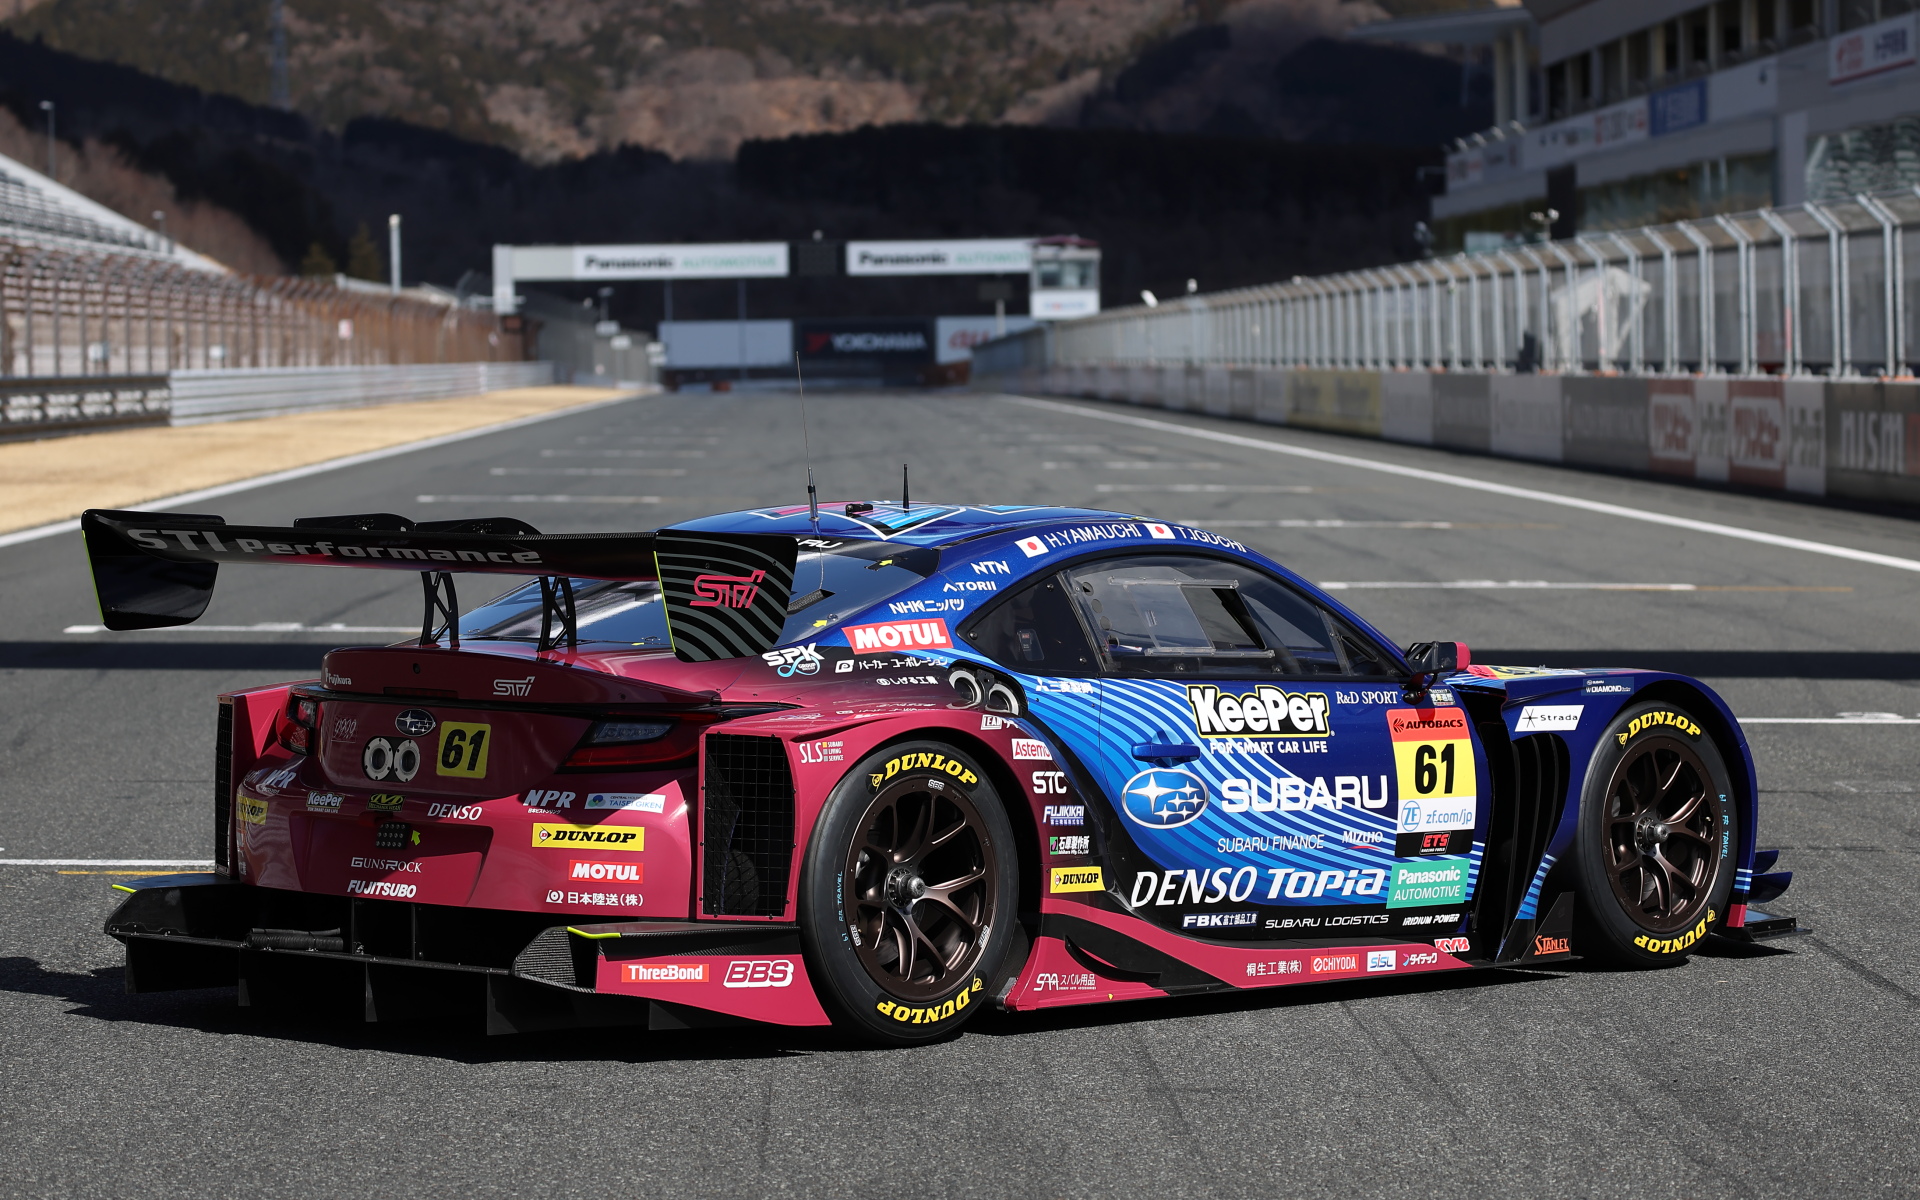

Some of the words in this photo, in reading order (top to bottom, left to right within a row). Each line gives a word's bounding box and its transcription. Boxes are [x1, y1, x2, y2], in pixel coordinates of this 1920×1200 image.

[584, 253, 674, 272] Panasonic
[681, 253, 777, 270] AUTOMOTIVE
[831, 332, 927, 352] YOKOHAMA
[126, 528, 225, 553] STI
[1044, 523, 1142, 548] H.YAMAUCHI
[1174, 526, 1247, 553] T.IGUCHI
[970, 560, 1011, 574] NTN
[853, 622, 947, 649] MOTUL
[762, 642, 826, 667] SPK
[1336, 691, 1359, 705] R&D
[1362, 691, 1398, 704] SPORT
[1189, 686, 1327, 734] KeePer
[1405, 719, 1464, 729] AUTOBACS
[1628, 711, 1701, 739] DUNLOP
[441, 728, 487, 771] 61
[799, 742, 823, 763] SLS
[1209, 742, 1233, 755] FOR
[1237, 742, 1275, 755] SMART
[1277, 741, 1300, 754] CAR
[1303, 741, 1328, 753] LIFE
[885, 752, 979, 785] DUNLOP
[1414, 743, 1455, 795] 61
[1032, 771, 1068, 794] STC
[522, 789, 577, 809] NPR
[1220, 775, 1389, 813] SUBARU
[427, 803, 483, 820] DENSO
[1425, 809, 1473, 825] zf.com/jp
[553, 830, 637, 844] DUNLOP
[1217, 836, 1270, 853] SUBARU
[1272, 834, 1324, 851] FINANCE
[1342, 830, 1384, 844] MIZUHO
[1423, 834, 1450, 848] ETS
[572, 863, 640, 881] MOTUL
[1061, 872, 1099, 885] DUNLOP
[1397, 866, 1461, 885] Panasonic
[347, 880, 417, 898] FUJITSUBO
[1130, 866, 1258, 908] DENSO
[1393, 885, 1461, 901] AUTOMOTIVE
[1183, 915, 1224, 928] FBK
[1264, 917, 1321, 928] SUBARU
[1324, 914, 1390, 927] LOGISTICS
[1402, 916, 1433, 926] IRIDIUM
[1433, 913, 1460, 924] POWER
[1433, 937, 1470, 953] KYB
[1534, 935, 1570, 955] STANLEY
[1634, 918, 1708, 954] DUNLOP
[628, 965, 703, 980] ThreeBond
[1323, 956, 1356, 971] CHIYODA
[723, 960, 794, 988] BBS
[877, 986, 972, 1024] DUNLOP
